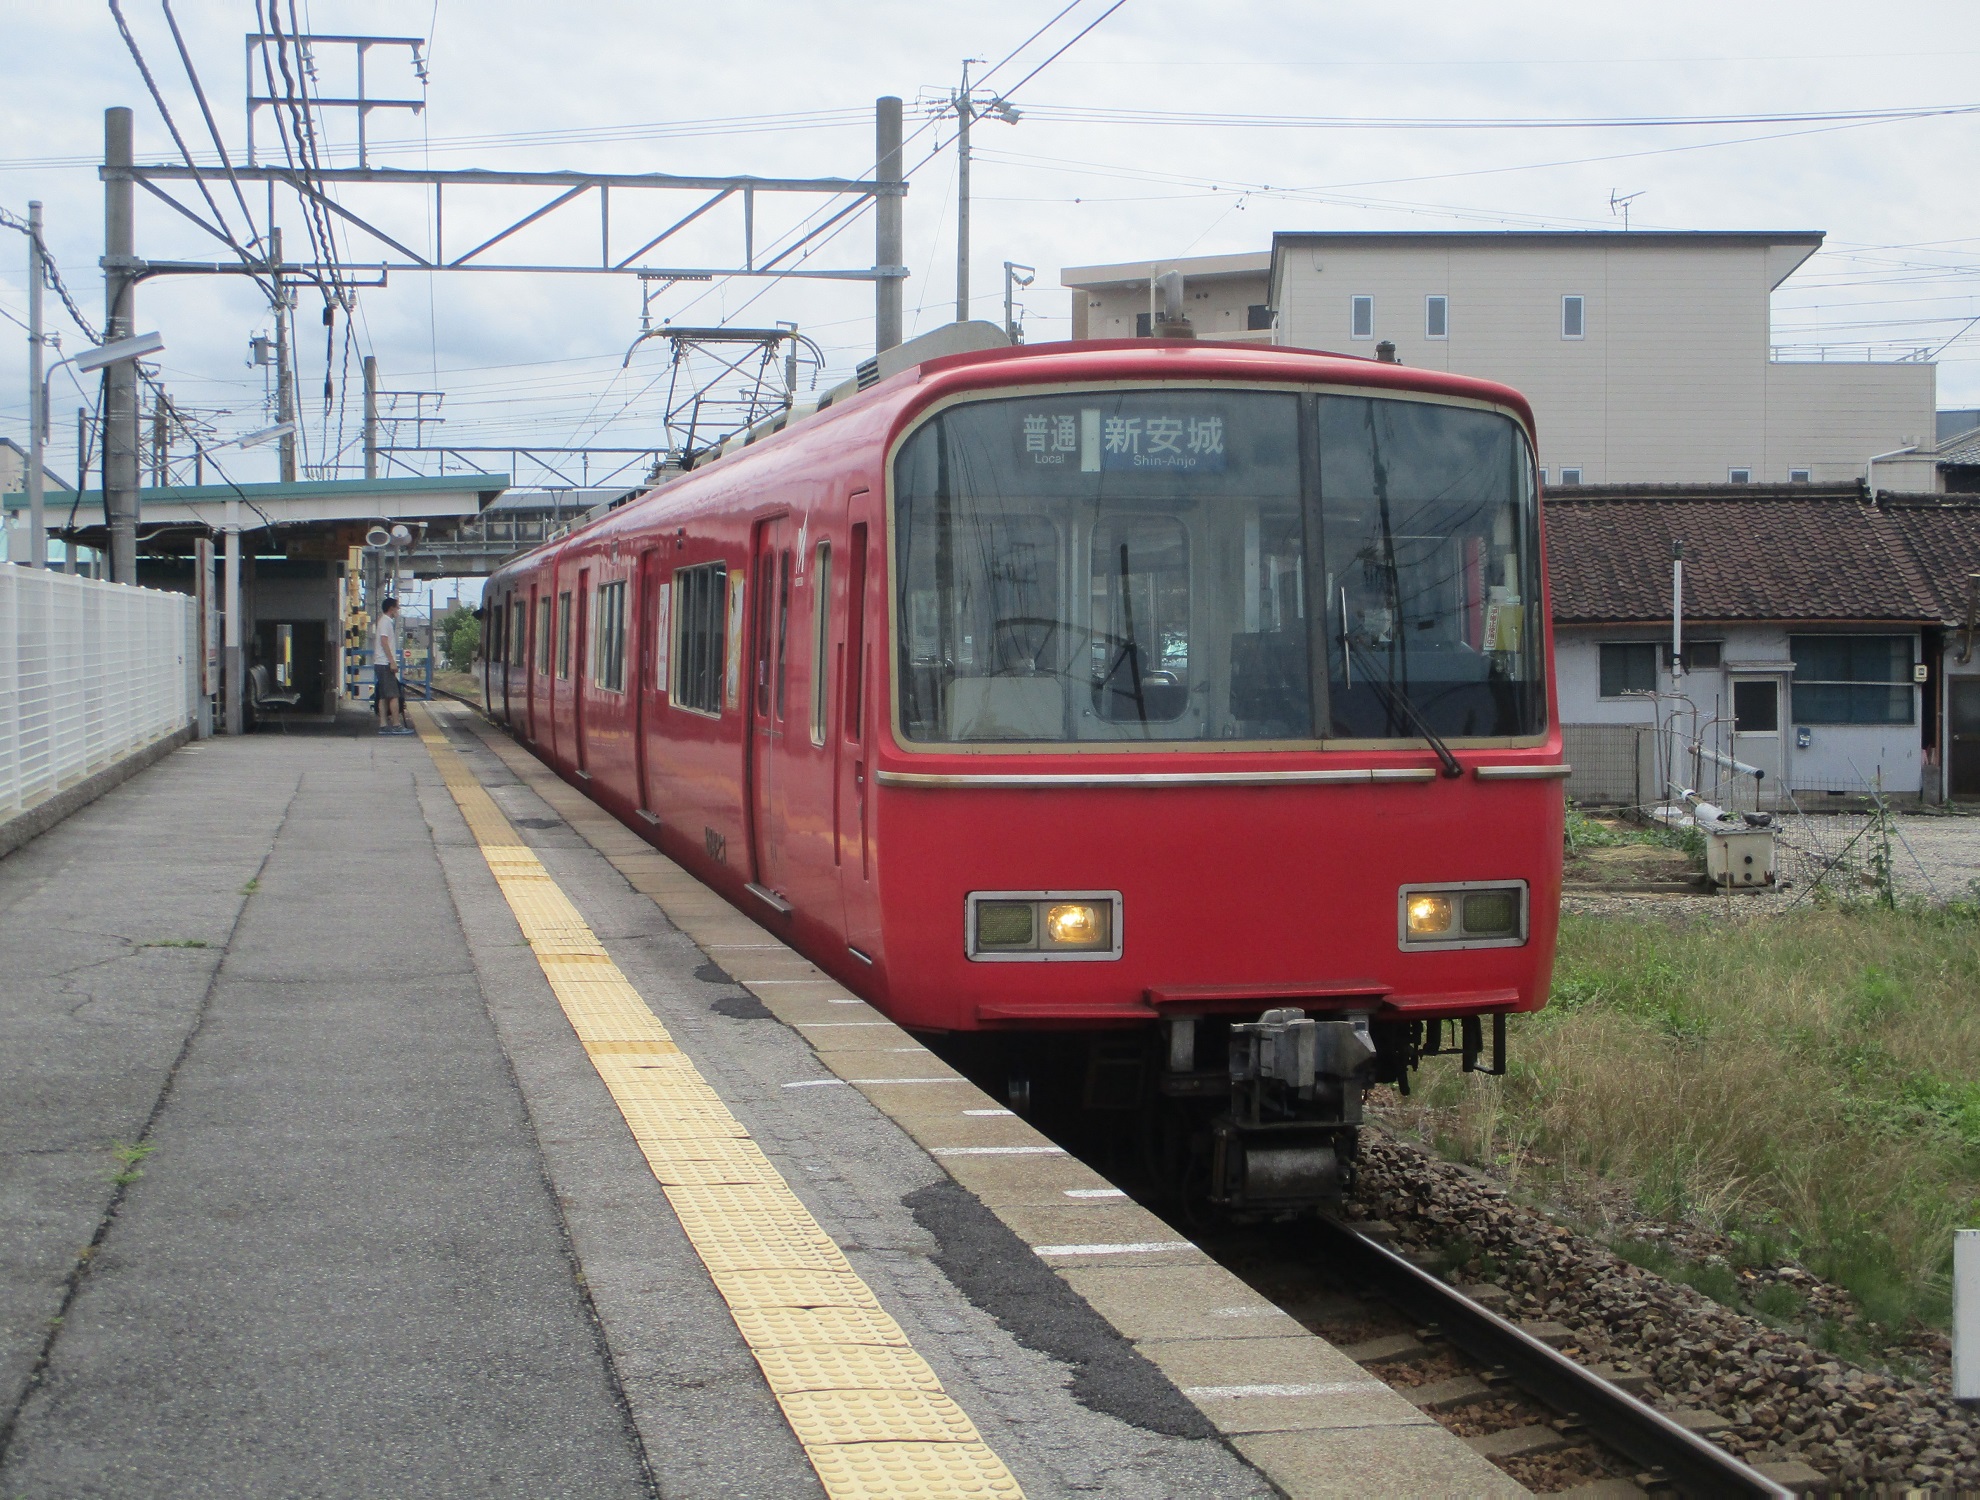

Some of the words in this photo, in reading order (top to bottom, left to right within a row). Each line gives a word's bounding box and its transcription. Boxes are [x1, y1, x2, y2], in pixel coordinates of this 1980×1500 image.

[1023, 413, 1077, 452] 普通
[1105, 416, 1224, 454] 新安城
[1034, 453, 1065, 464] Local
[1133, 454, 1196, 468] Shin-Anjo
